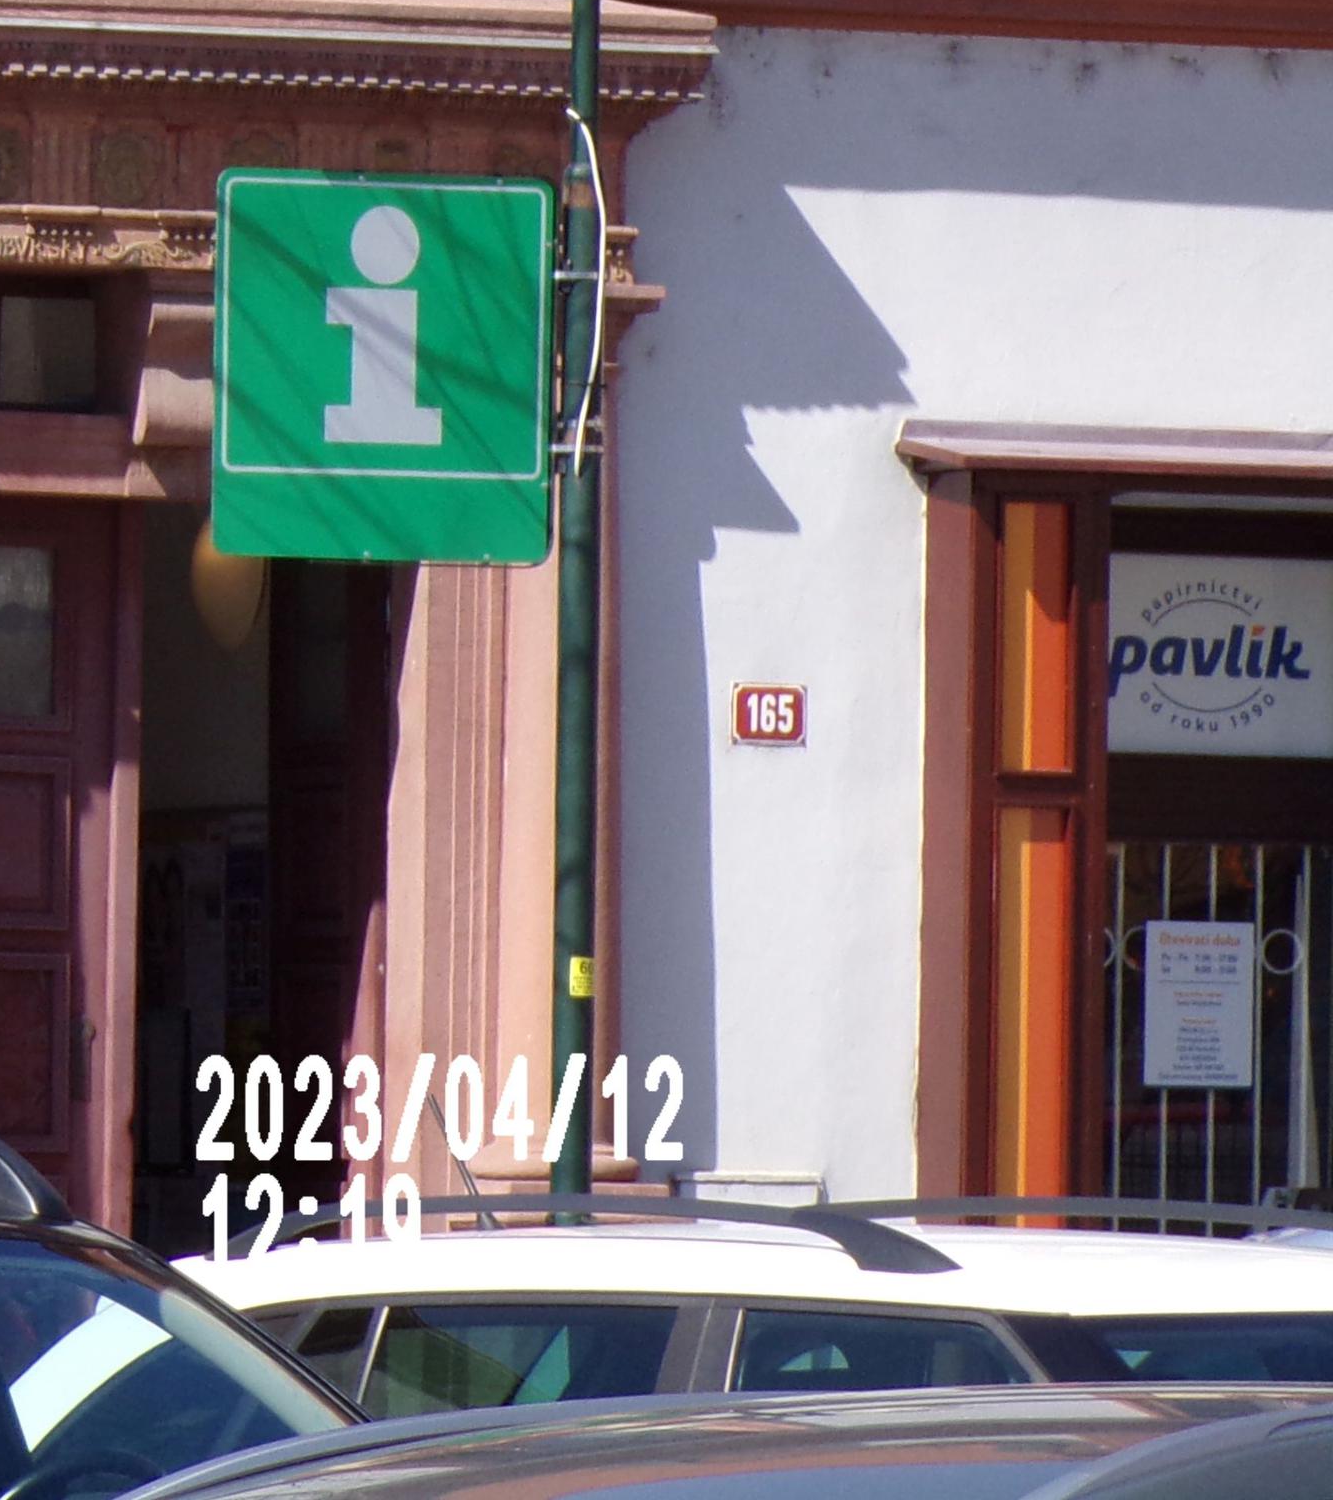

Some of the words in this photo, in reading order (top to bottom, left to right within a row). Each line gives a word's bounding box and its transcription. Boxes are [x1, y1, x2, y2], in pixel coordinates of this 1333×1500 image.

[747, 693, 794, 733] 165
[1140, 691, 1163, 713] od
[1170, 713, 1219, 733] roku
[1230, 692, 1276, 729] 1990
